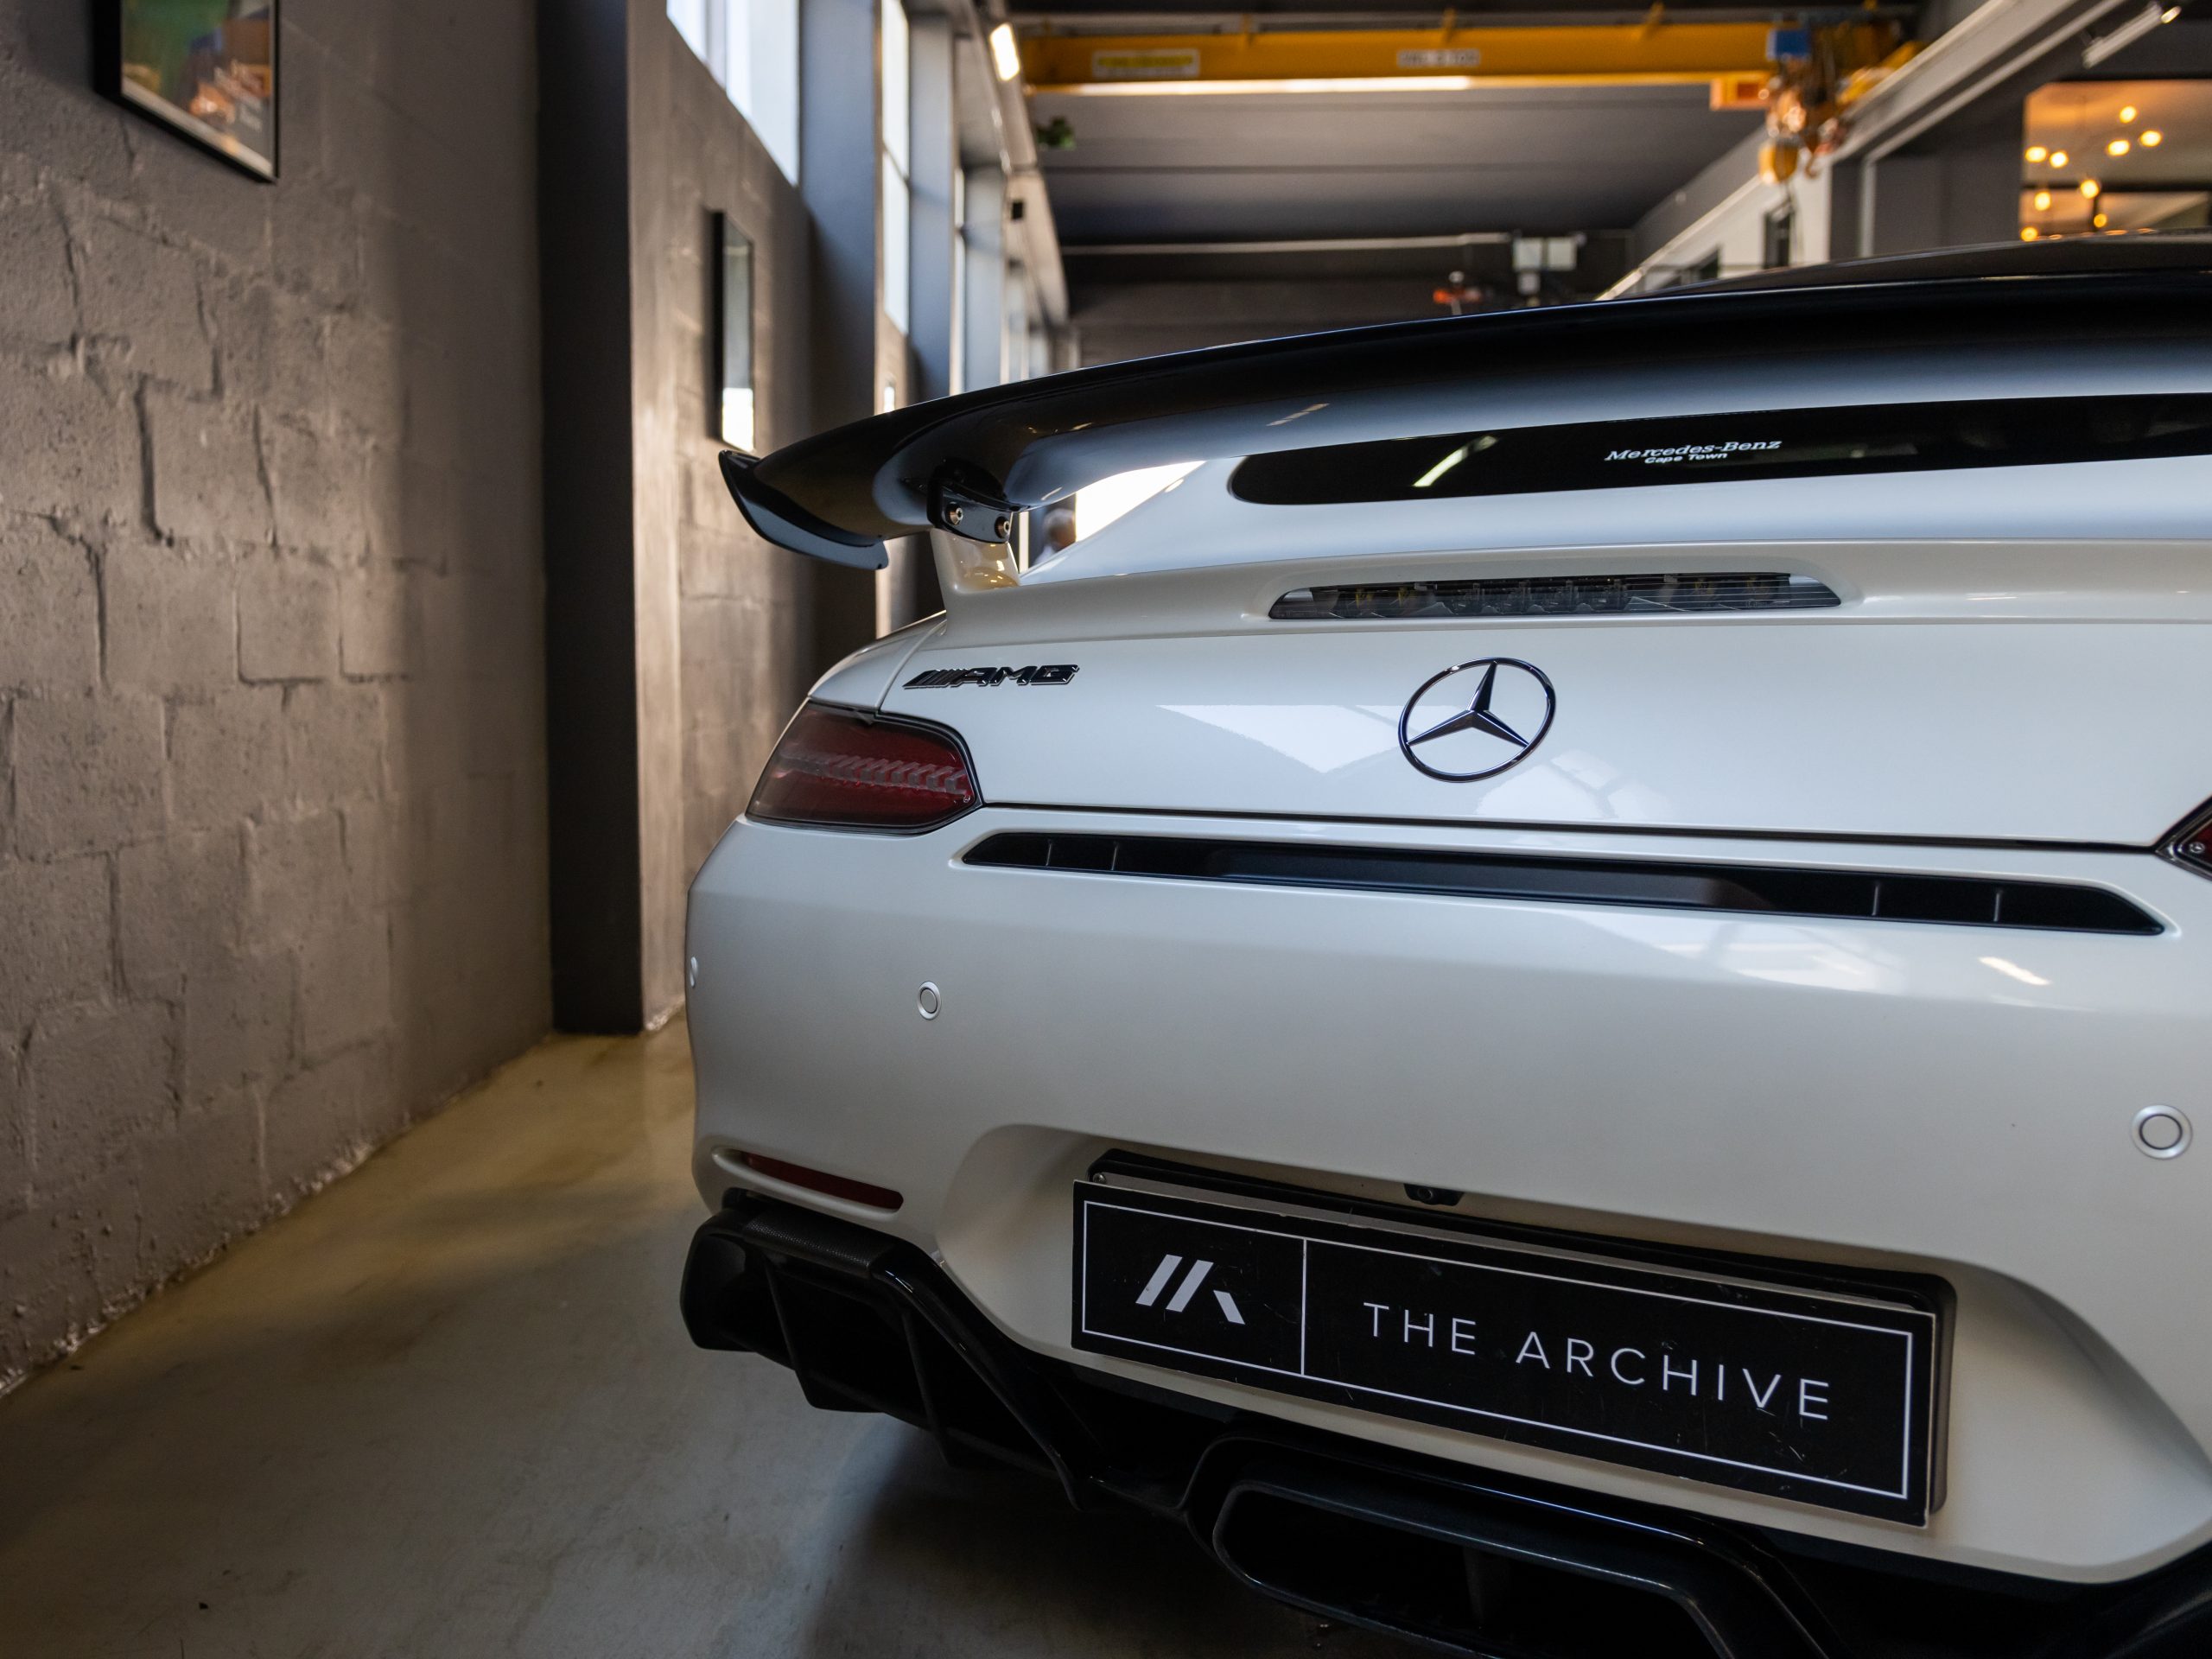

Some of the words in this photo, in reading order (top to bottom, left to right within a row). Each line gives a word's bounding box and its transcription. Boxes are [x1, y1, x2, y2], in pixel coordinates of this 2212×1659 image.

[1604, 441, 1783, 461] Mercedes-Benz
[1644, 455, 1683, 464] Cape
[1688, 453, 1728, 461] Town
[947, 664, 1080, 688] AMG
[1363, 1302, 1477, 1356] THE
[1516, 1331, 1830, 1421] ARCHIVE
